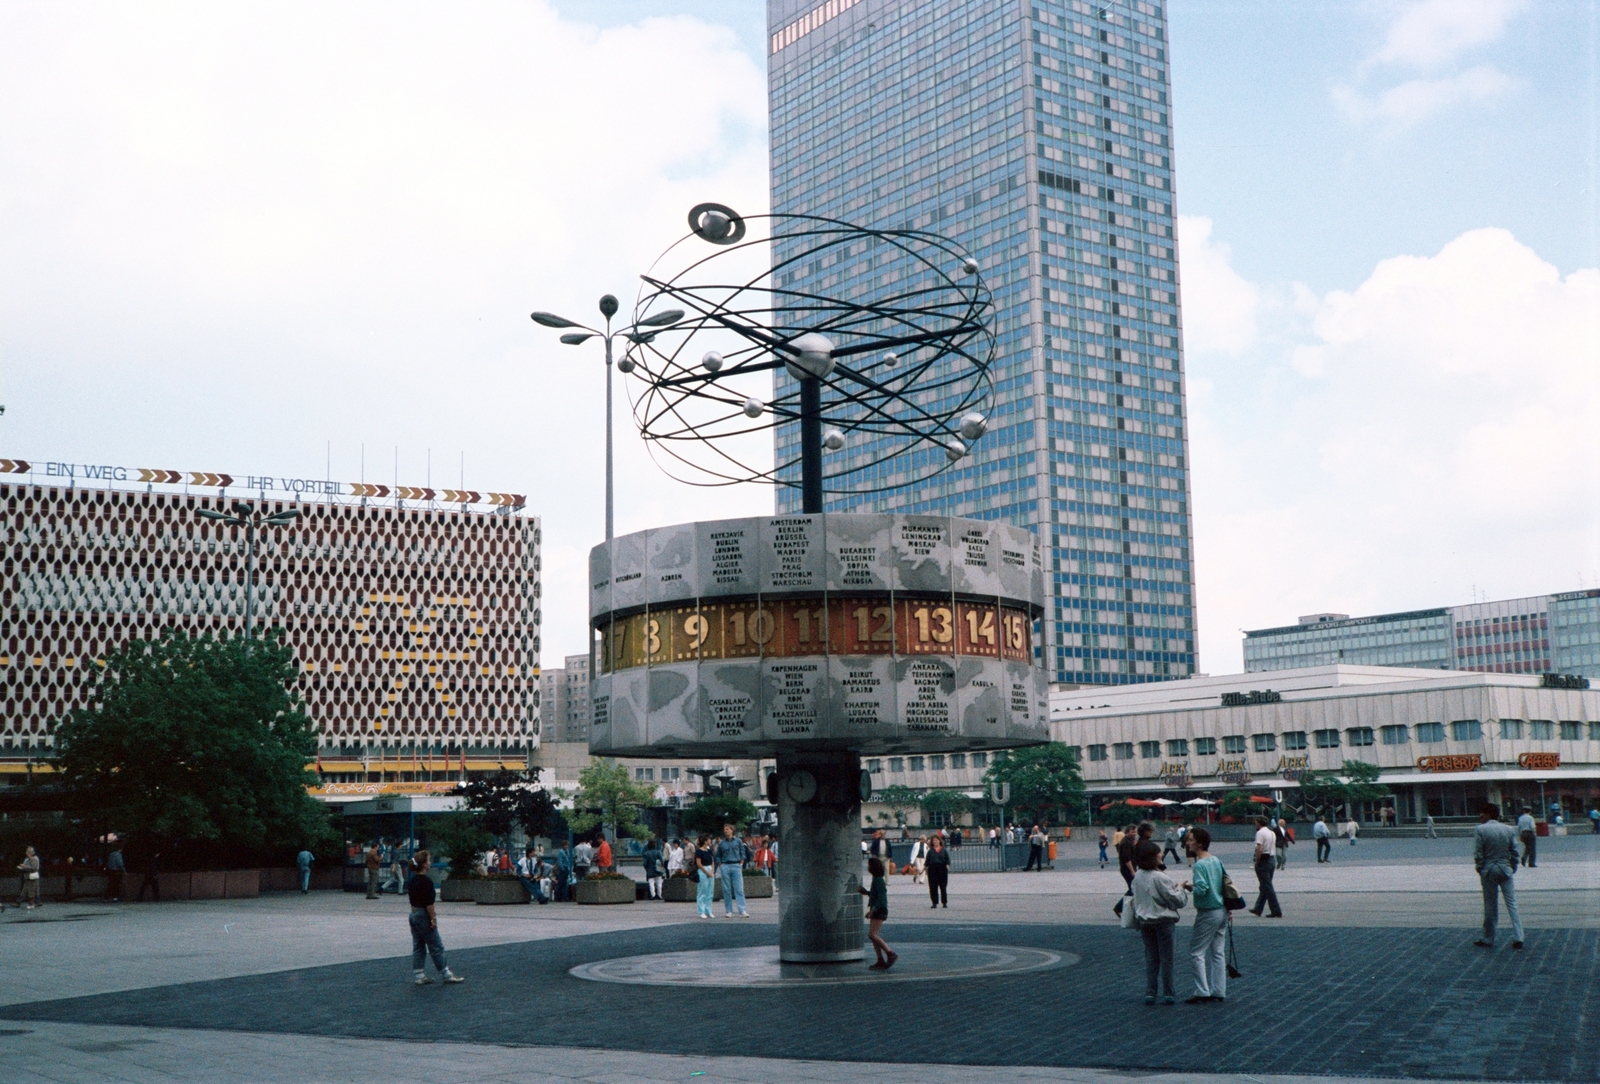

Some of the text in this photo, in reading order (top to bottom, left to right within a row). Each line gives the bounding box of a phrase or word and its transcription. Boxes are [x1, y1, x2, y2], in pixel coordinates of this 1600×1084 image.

[46, 462, 127, 481] EIN WEG
[247, 475, 346, 495] IHR VORTEIL
[770, 518, 812, 526] AMSTERDAM
[778, 526, 804, 534] BERLIN
[902, 525, 940, 533] MURMANSK
[775, 533, 807, 541] BRÜSSEL
[901, 533, 942, 541] LENINGRAD
[961, 536, 990, 546] WOLGOGRAD
[716, 539, 739, 547] DUBLIN
[773, 541, 809, 549] BUDAPEST
[908, 541, 936, 549] MOSKAU
[715, 546, 740, 554] LONDON
[839, 547, 876, 555] BUKAREST
[968, 544, 983, 552] BAKU
[712, 553, 743, 561] LISSABON
[716, 561, 739, 569] ALGIER
[847, 562, 869, 570] SOFIA
[712, 568, 743, 576] MADEIRA
[771, 571, 813, 579] STOCKHOLM
[843, 577, 873, 585] NIKOSIA
[729, 609, 775, 646] 10
[793, 608, 827, 643] 11
[852, 607, 897, 643] 12
[914, 607, 953, 643] 13
[966, 610, 995, 645] 14
[684, 614, 709, 650] 9
[1003, 615, 1023, 650] 15
[642, 619, 661, 655] 8
[771, 664, 818, 672] KOPENHAGEN
[709, 698, 751, 706] CASABLANCA
[772, 710, 818, 718] BRAZZAVILLE
[716, 721, 745, 729] BAMAKO
[777, 718, 814, 726] KINSHASA
[781, 726, 810, 734] LUANDA
[1417, 753, 1482, 773] CAFETERIA
[1519, 752, 1562, 771] CAFETERIA
[990, 782, 1011, 805] U
[1275, 790, 1283, 803] U
